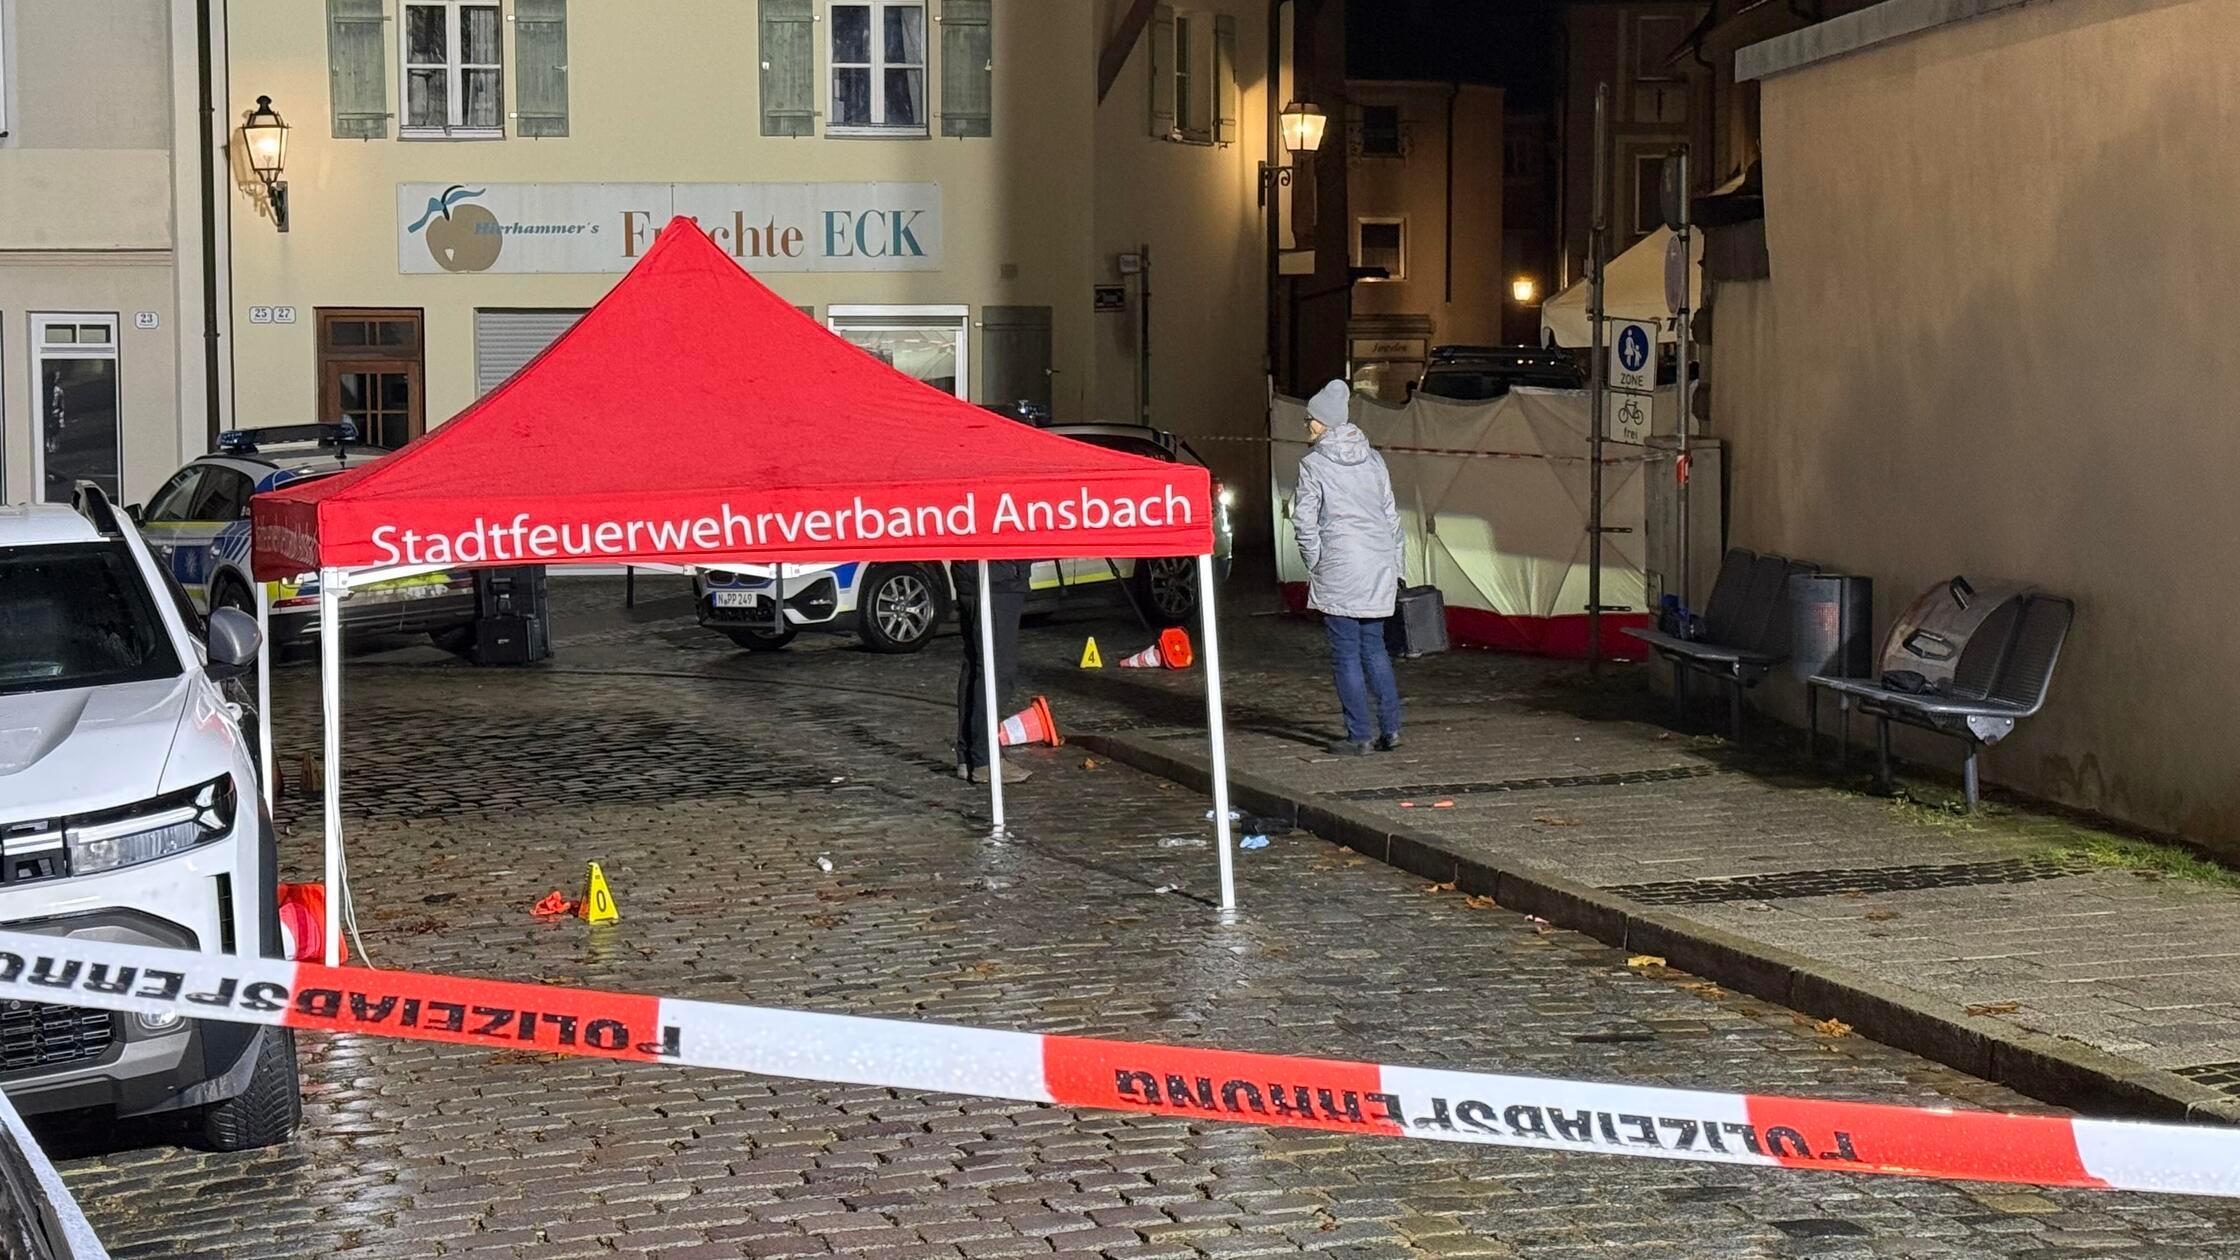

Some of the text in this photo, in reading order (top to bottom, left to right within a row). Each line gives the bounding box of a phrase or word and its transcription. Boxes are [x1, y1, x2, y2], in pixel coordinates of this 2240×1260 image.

[474, 222, 599, 235] Hierhammer's
[820, 209, 928, 258] ECK
[140, 313, 153, 323] 23
[255, 308, 267, 318] 25
[278, 308, 290, 318] 27
[1620, 373, 1644, 387] ZONE
[1623, 426, 1639, 440] frei
[371, 492, 977, 566] Stadtfeuerwehrverband
[992, 484, 1192, 533] Ansbach
[738, 593, 753, 605] 249
[1088, 650, 1096, 664] 4
[596, 889, 607, 913] 0
